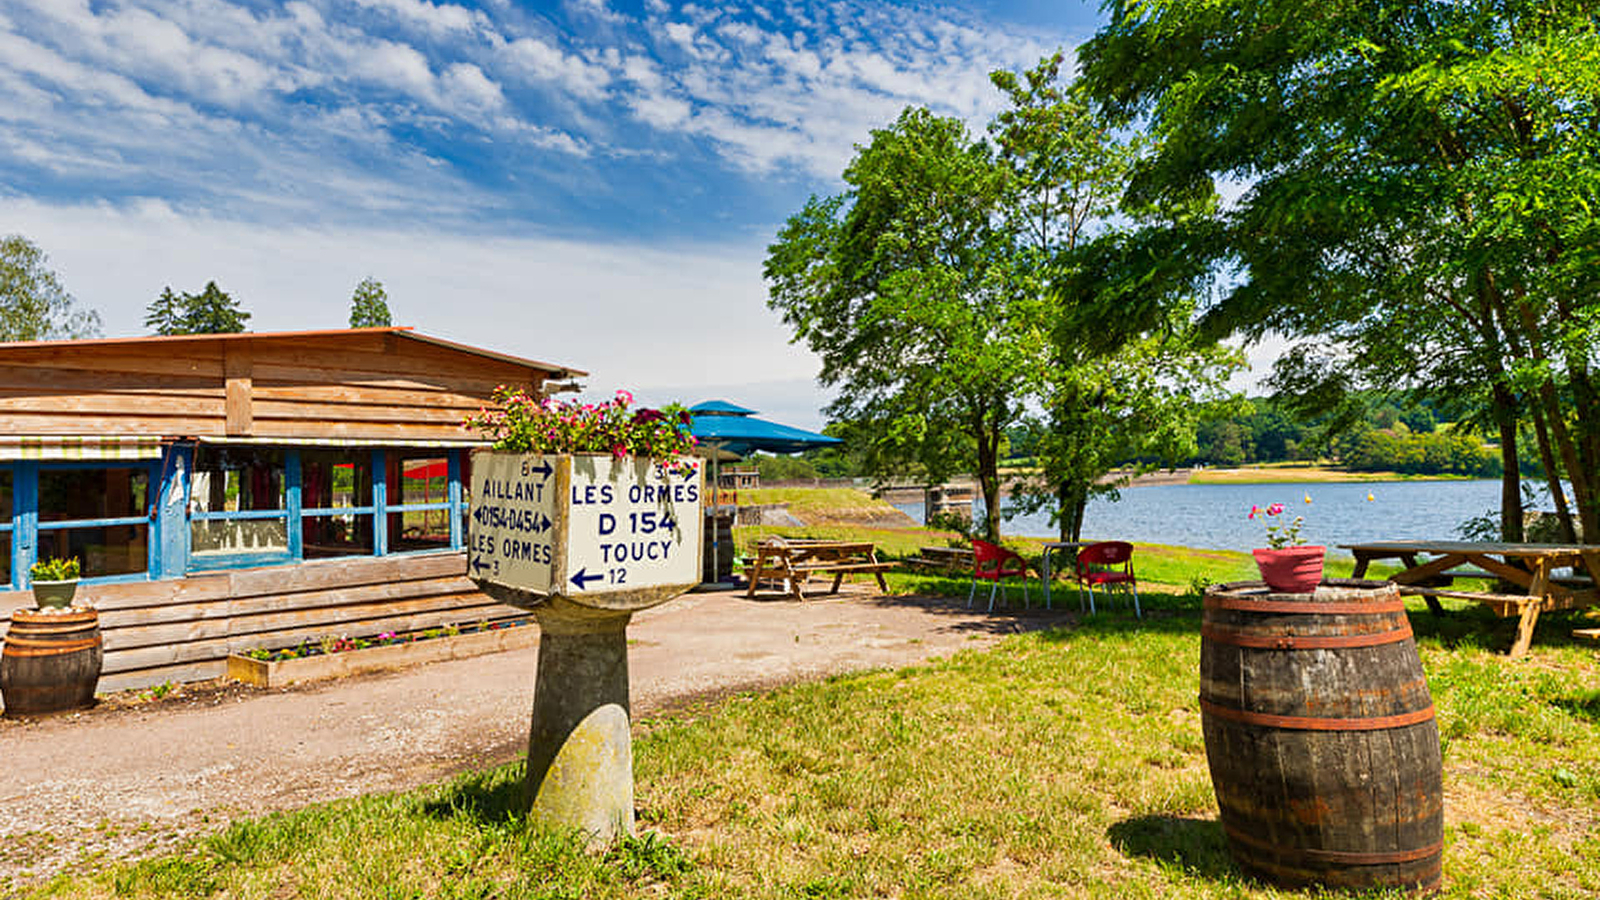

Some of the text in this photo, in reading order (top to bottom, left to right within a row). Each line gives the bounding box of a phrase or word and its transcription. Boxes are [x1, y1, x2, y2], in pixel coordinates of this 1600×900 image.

[654, 464, 664, 480] 3
[482, 478, 544, 503] AILLANT
[572, 485, 699, 505] LES ORMES
[599, 512, 676, 536] D 154
[472, 534, 552, 565] LES ORMES
[600, 540, 672, 563] TOUCY
[609, 568, 627, 584] 12
